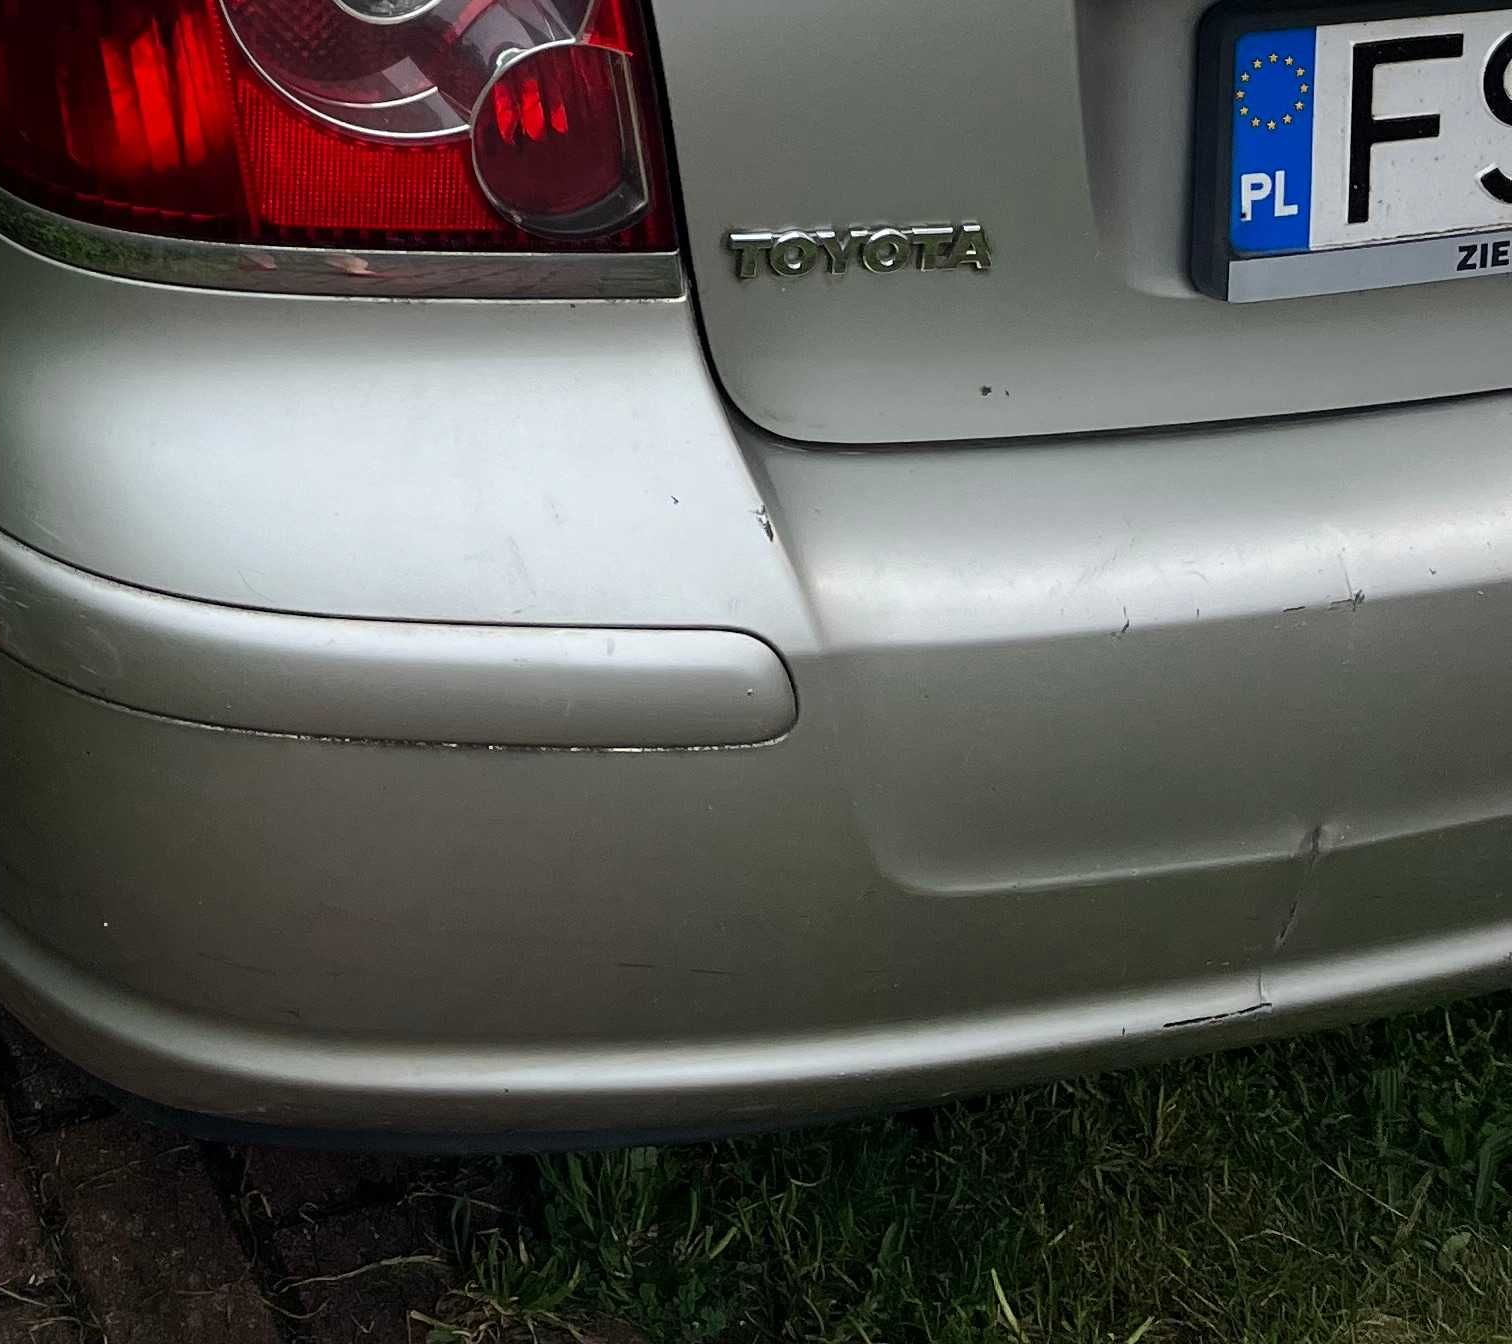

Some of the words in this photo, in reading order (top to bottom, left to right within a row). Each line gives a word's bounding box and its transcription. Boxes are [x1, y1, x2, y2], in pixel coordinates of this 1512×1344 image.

[1241, 170, 1298, 221] PL
[728, 223, 992, 278] TOYOTA
[1456, 240, 1511, 272] ZIE
